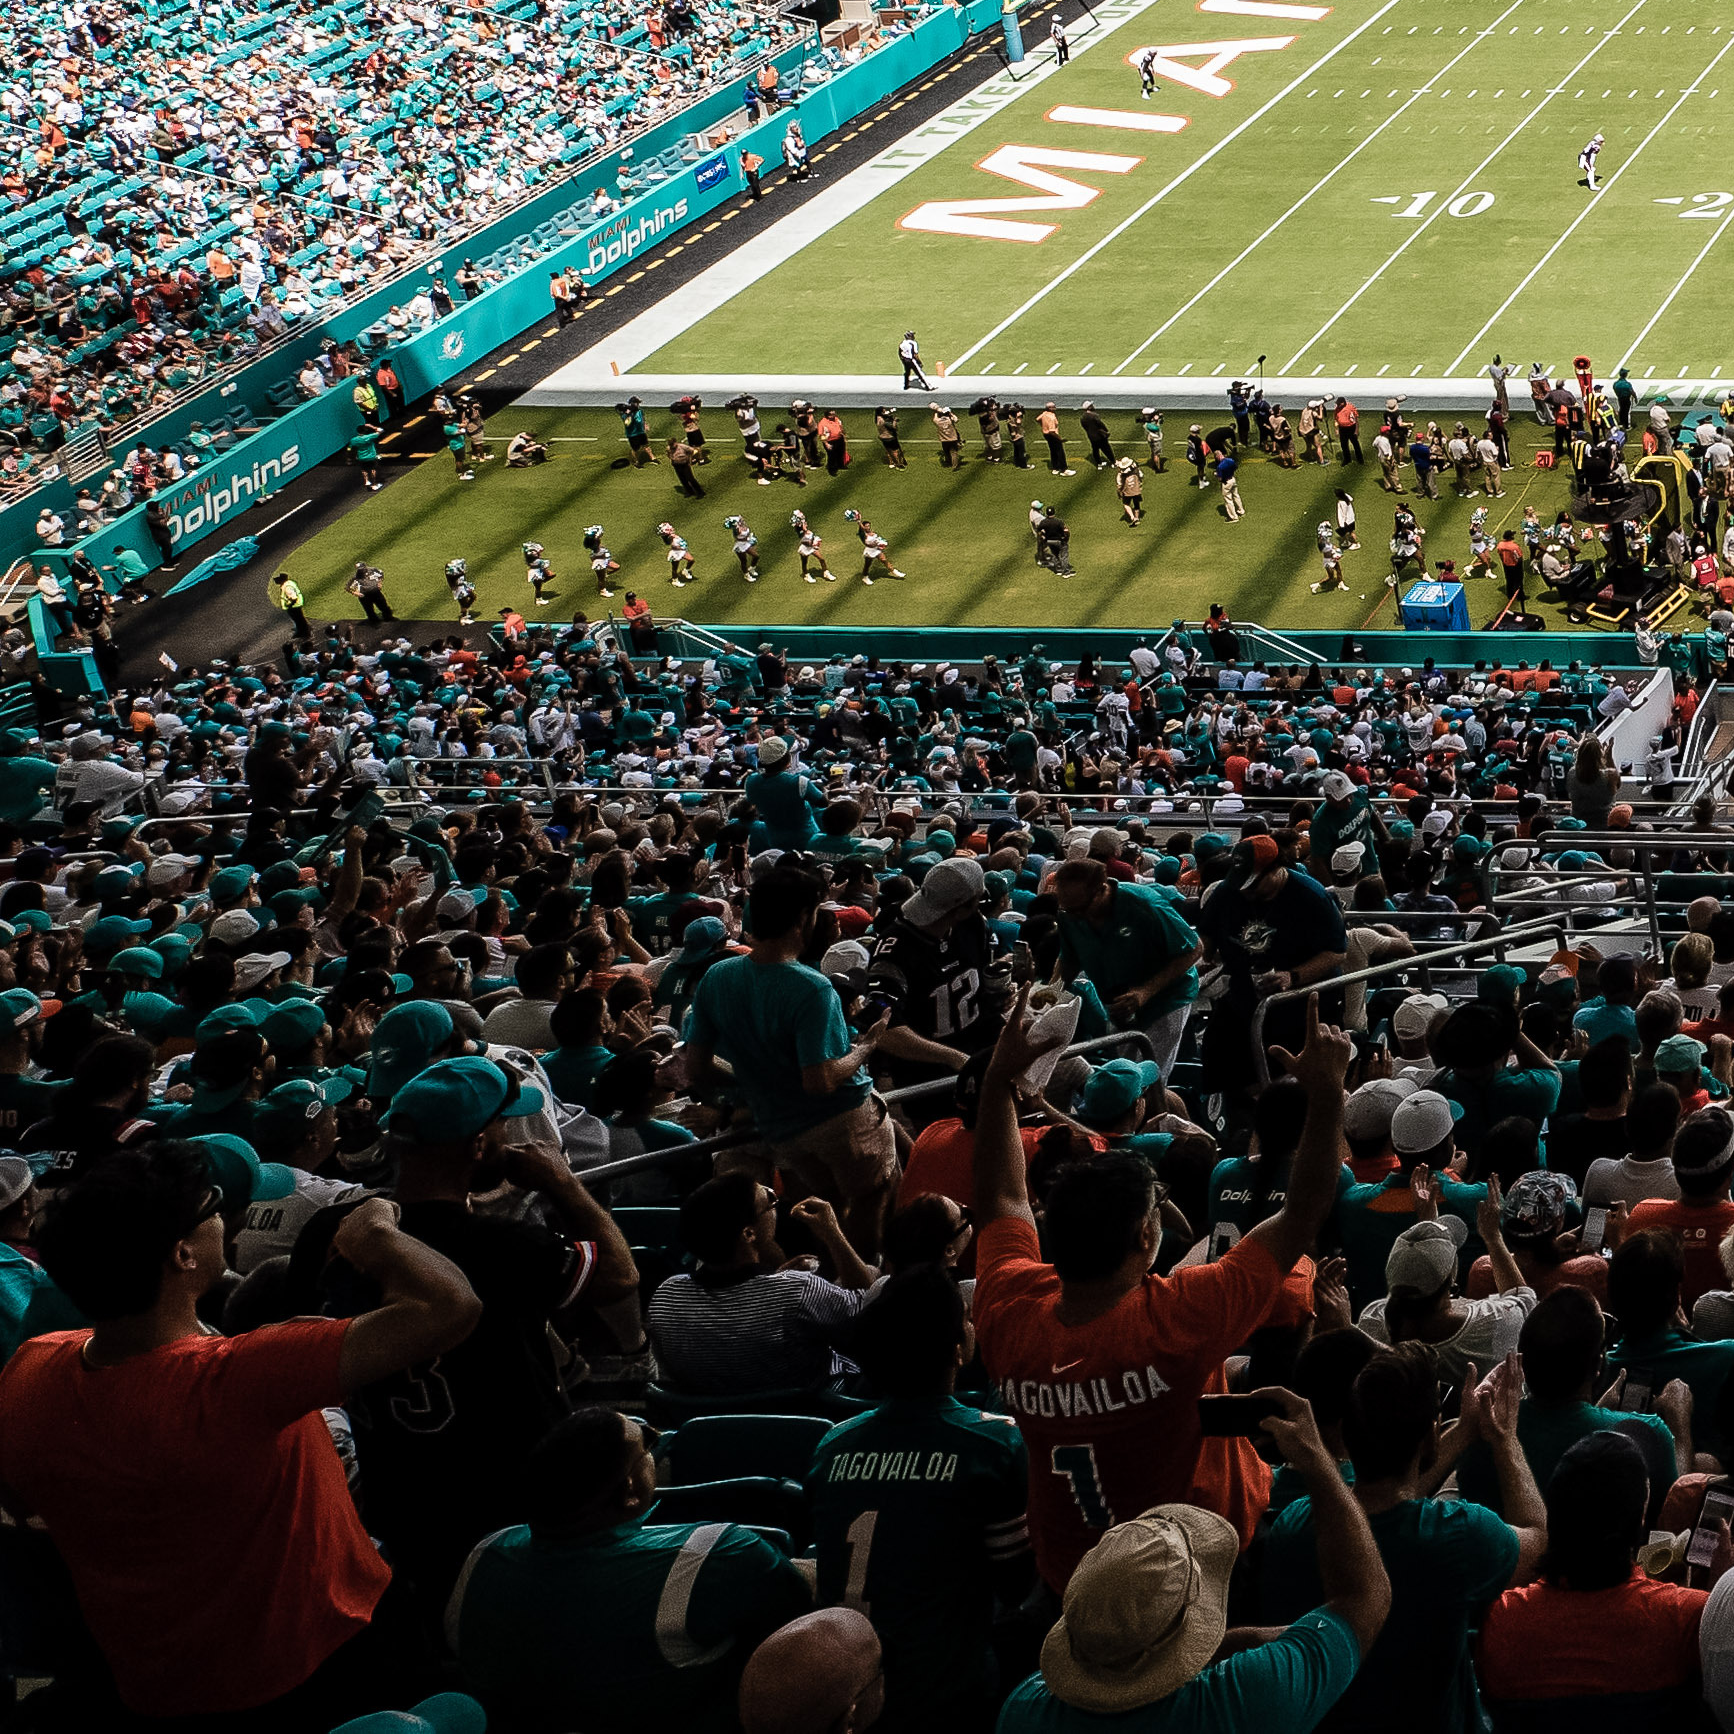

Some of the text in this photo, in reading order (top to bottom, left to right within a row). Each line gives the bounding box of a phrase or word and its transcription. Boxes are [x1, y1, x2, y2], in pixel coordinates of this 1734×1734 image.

[585, 196, 689, 276] Dolphins
[1390, 191, 1496, 218] 10
[166, 442, 301, 546] Dolphins
[929, 968, 980, 1038] 12
[999, 1365, 1171, 1418] AGOVAILOA
[828, 1451, 958, 1483] TAGOVAILOA
[1051, 1443, 1116, 1528] 1
[844, 1510, 878, 1618] 1
